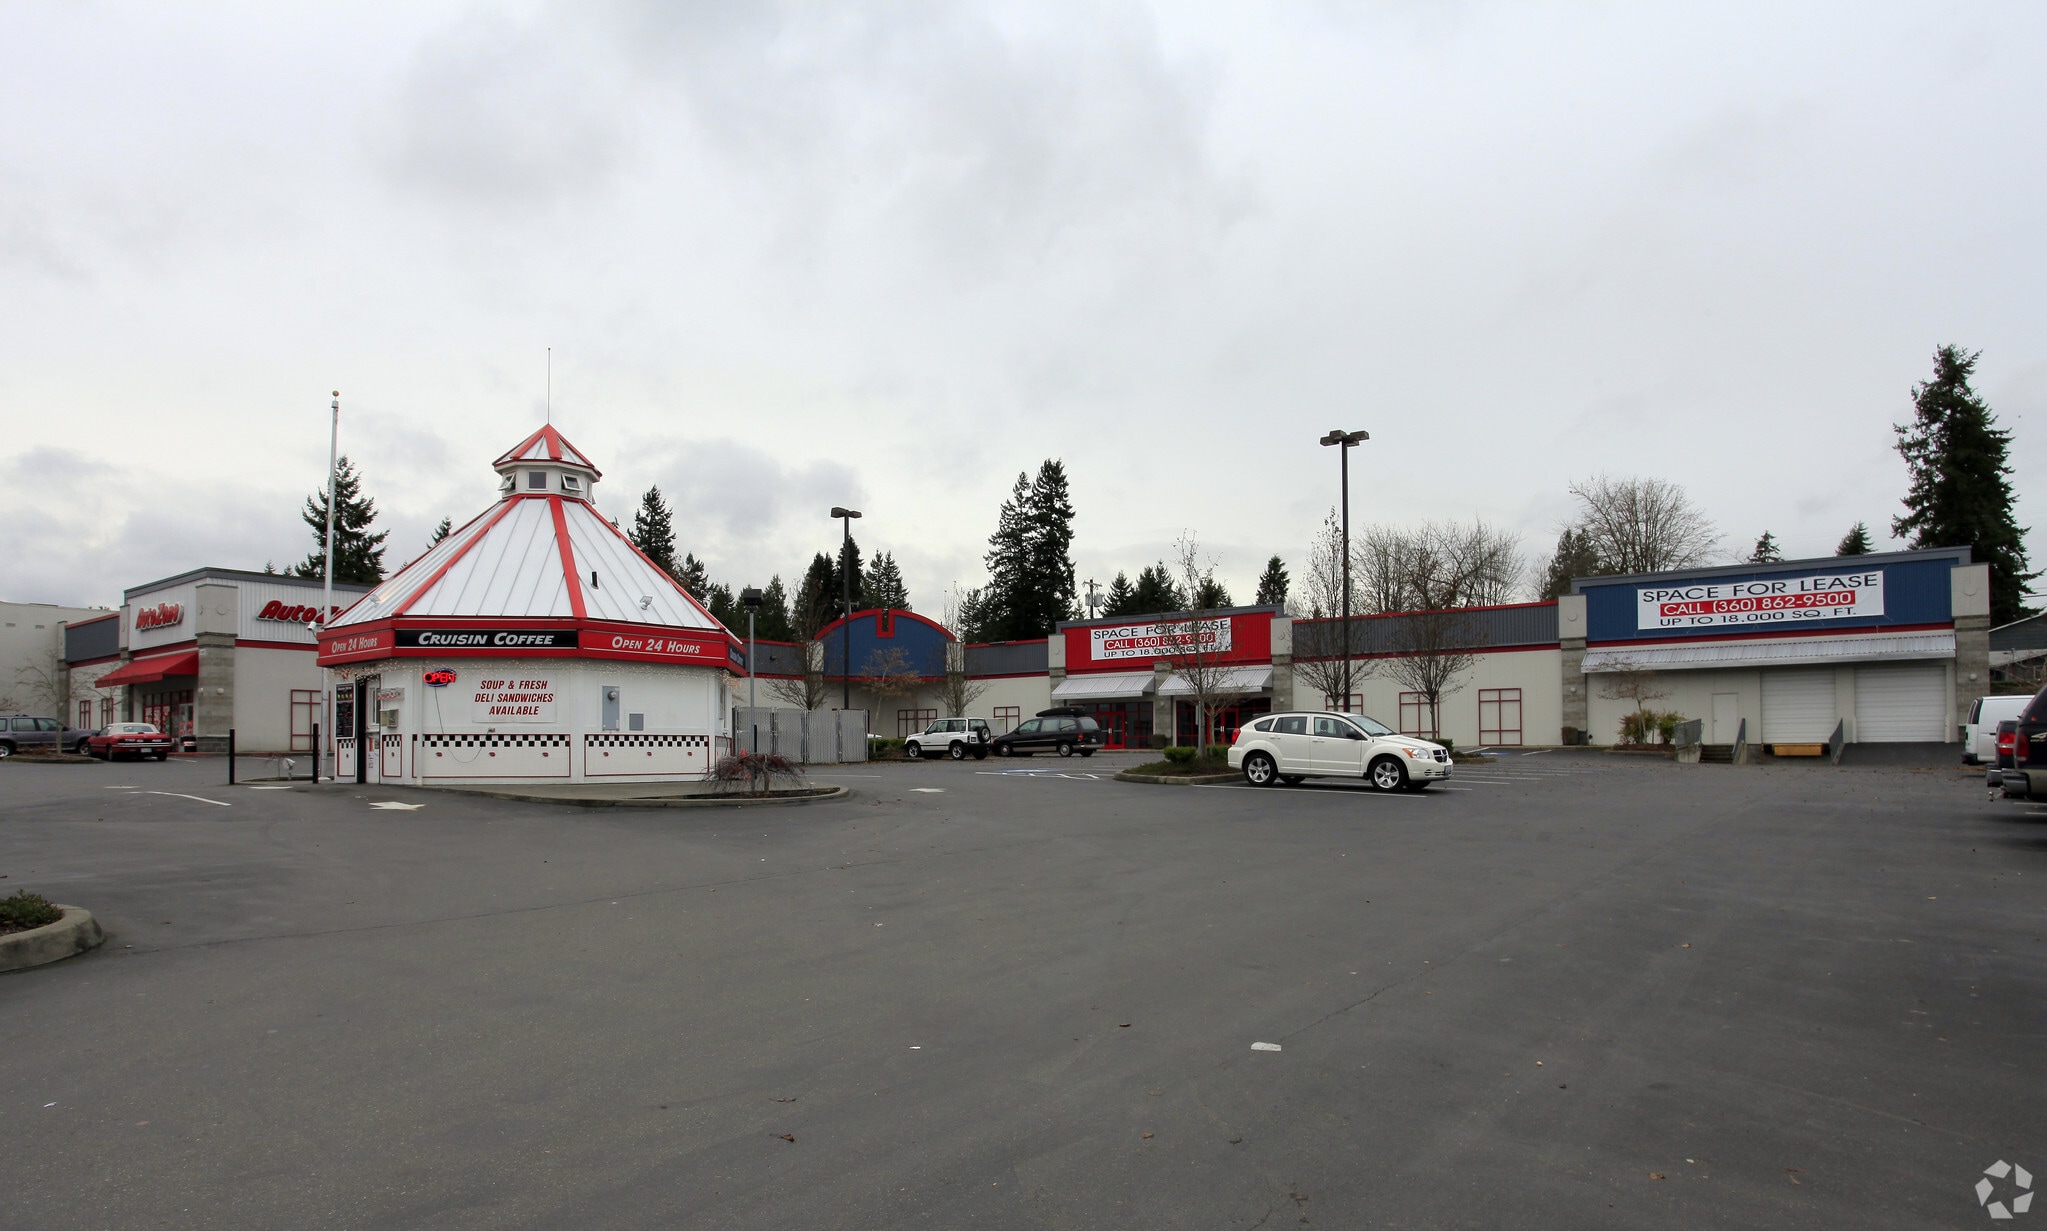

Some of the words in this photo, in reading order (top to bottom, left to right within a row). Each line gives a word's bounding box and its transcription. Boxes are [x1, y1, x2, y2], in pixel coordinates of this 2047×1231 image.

[1642, 586, 1718, 602] SPACE
[1733, 582, 1786, 597] FOR
[1800, 574, 1878, 592] LEASE
[257, 599, 343, 624] AutoZ
[1664, 602, 1704, 615] CALL
[1713, 598, 1756, 614] (360)
[1762, 592, 1852, 609] 862-9500
[136, 602, 180, 630] AutoZone
[1660, 618, 1682, 626] UP
[1688, 616, 1713, 625] TO
[1792, 609, 1826, 618] SQ.
[1834, 606, 1856, 616] FT.
[1094, 628, 1138, 640] SPACE
[1146, 625, 1176, 636] FOR
[1184, 620, 1228, 633] LASE
[348, 638, 357, 652] 24
[646, 638, 664, 652] 24
[1106, 640, 1130, 650] CALL
[1134, 638, 1160, 648] (360)
[1162, 634, 1214, 645] 862-900
[423, 671, 456, 683] OPEN
[480, 680, 505, 690] SOUP
[508, 680, 514, 690] &
[518, 680, 548, 690] FRESH
[474, 694, 494, 702] DELI
[497, 694, 554, 702] SANDWICHES
[489, 706, 539, 715] AVAILABLE
